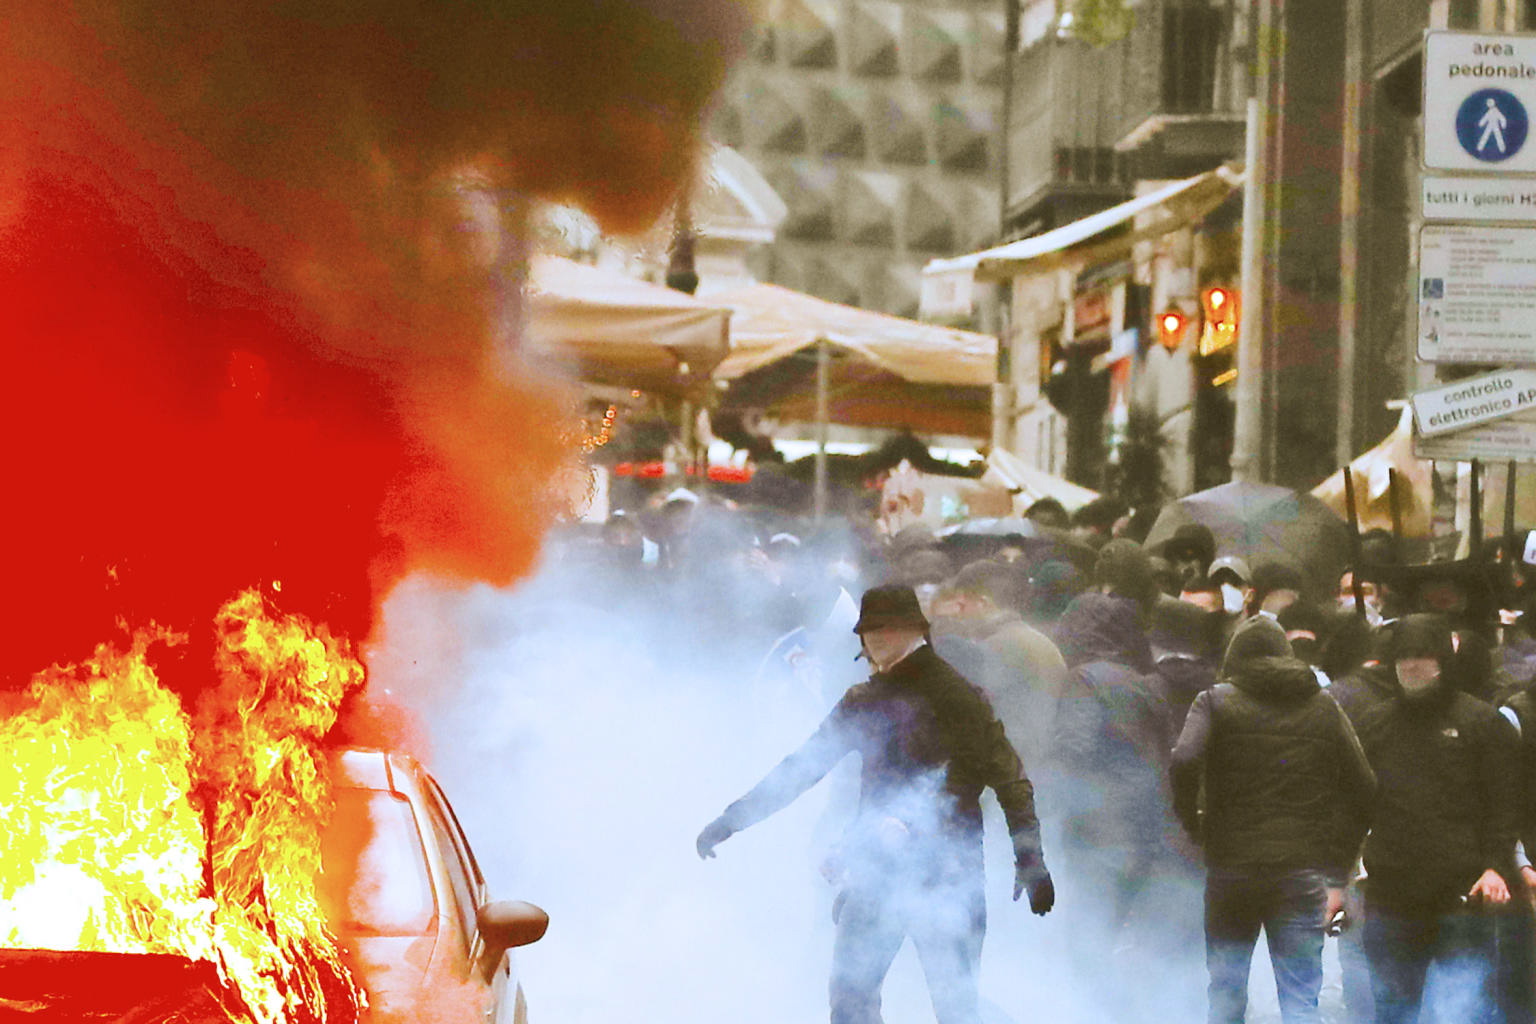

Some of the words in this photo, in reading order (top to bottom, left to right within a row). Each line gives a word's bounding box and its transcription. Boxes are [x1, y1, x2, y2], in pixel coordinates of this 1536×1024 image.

[1473, 43, 1514, 56] area
[1449, 62, 1536, 78] pedonale
[1427, 192, 1458, 203] tutti
[1464, 192, 1468, 203] i
[1473, 192, 1514, 207] giorni
[1444, 378, 1513, 404] controllo
[1429, 398, 1512, 426] elettronico
